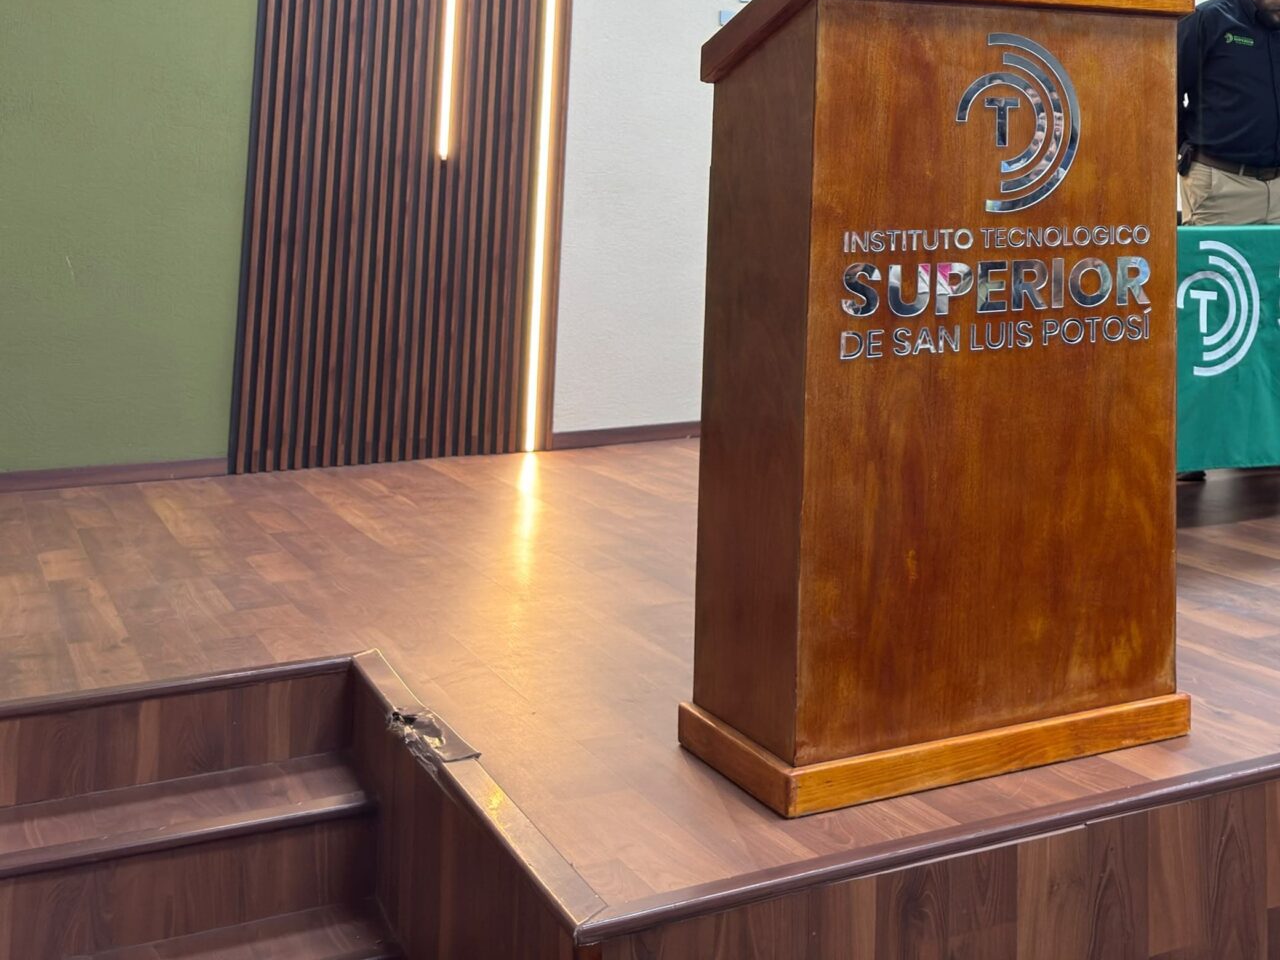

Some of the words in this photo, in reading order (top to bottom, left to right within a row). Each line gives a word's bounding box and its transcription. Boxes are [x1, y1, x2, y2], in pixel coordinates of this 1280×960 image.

[842, 227, 974, 253] INSTITUTO
[980, 224, 1151, 249] TECNOLOGICO
[841, 255, 1151, 318] SUPERIOR
[840, 329, 885, 360] DE
[893, 325, 961, 356] SAN
[970, 320, 1034, 351] LUIS
[1042, 307, 1153, 346] POTOSÍ
